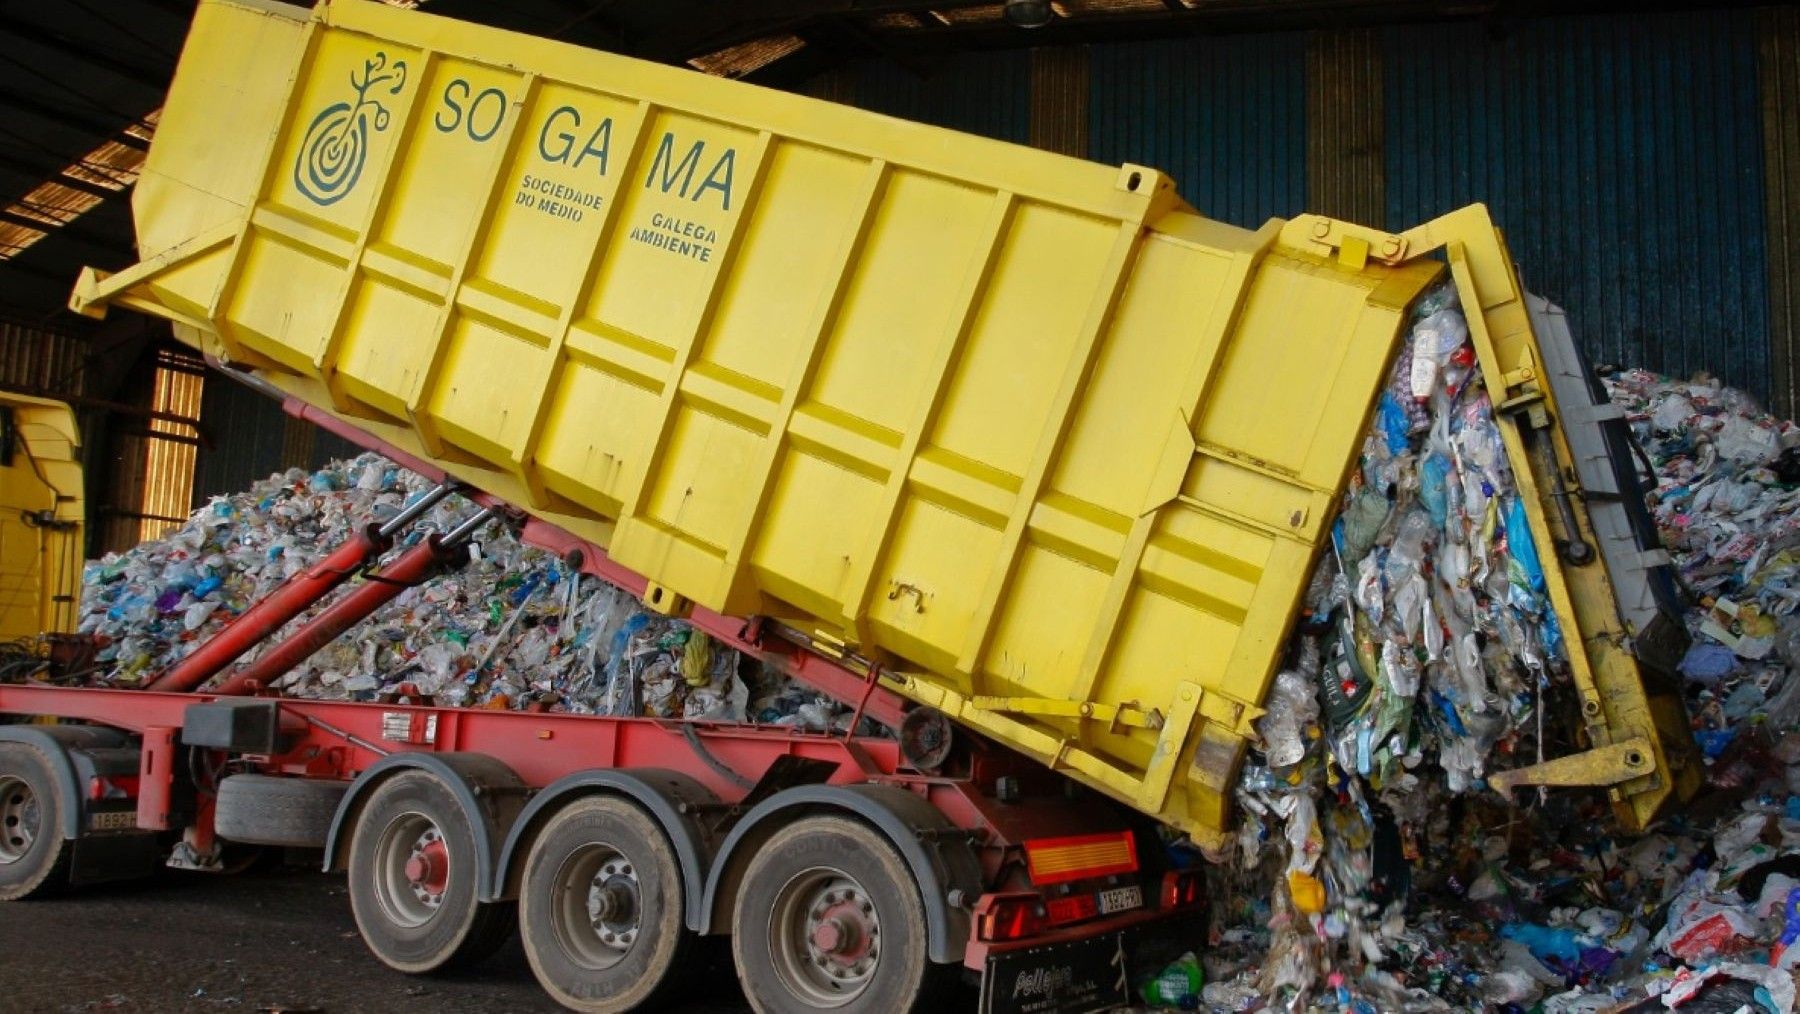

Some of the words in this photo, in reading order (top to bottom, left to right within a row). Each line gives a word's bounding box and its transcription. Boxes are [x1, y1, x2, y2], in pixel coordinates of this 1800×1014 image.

[515, 191, 535, 208] DO
[538, 198, 584, 223] MEDIO
[630, 227, 713, 262] AMBIENTE
[522, 175, 603, 210] SOCIEDADE
[652, 213, 716, 243] GALEGA
